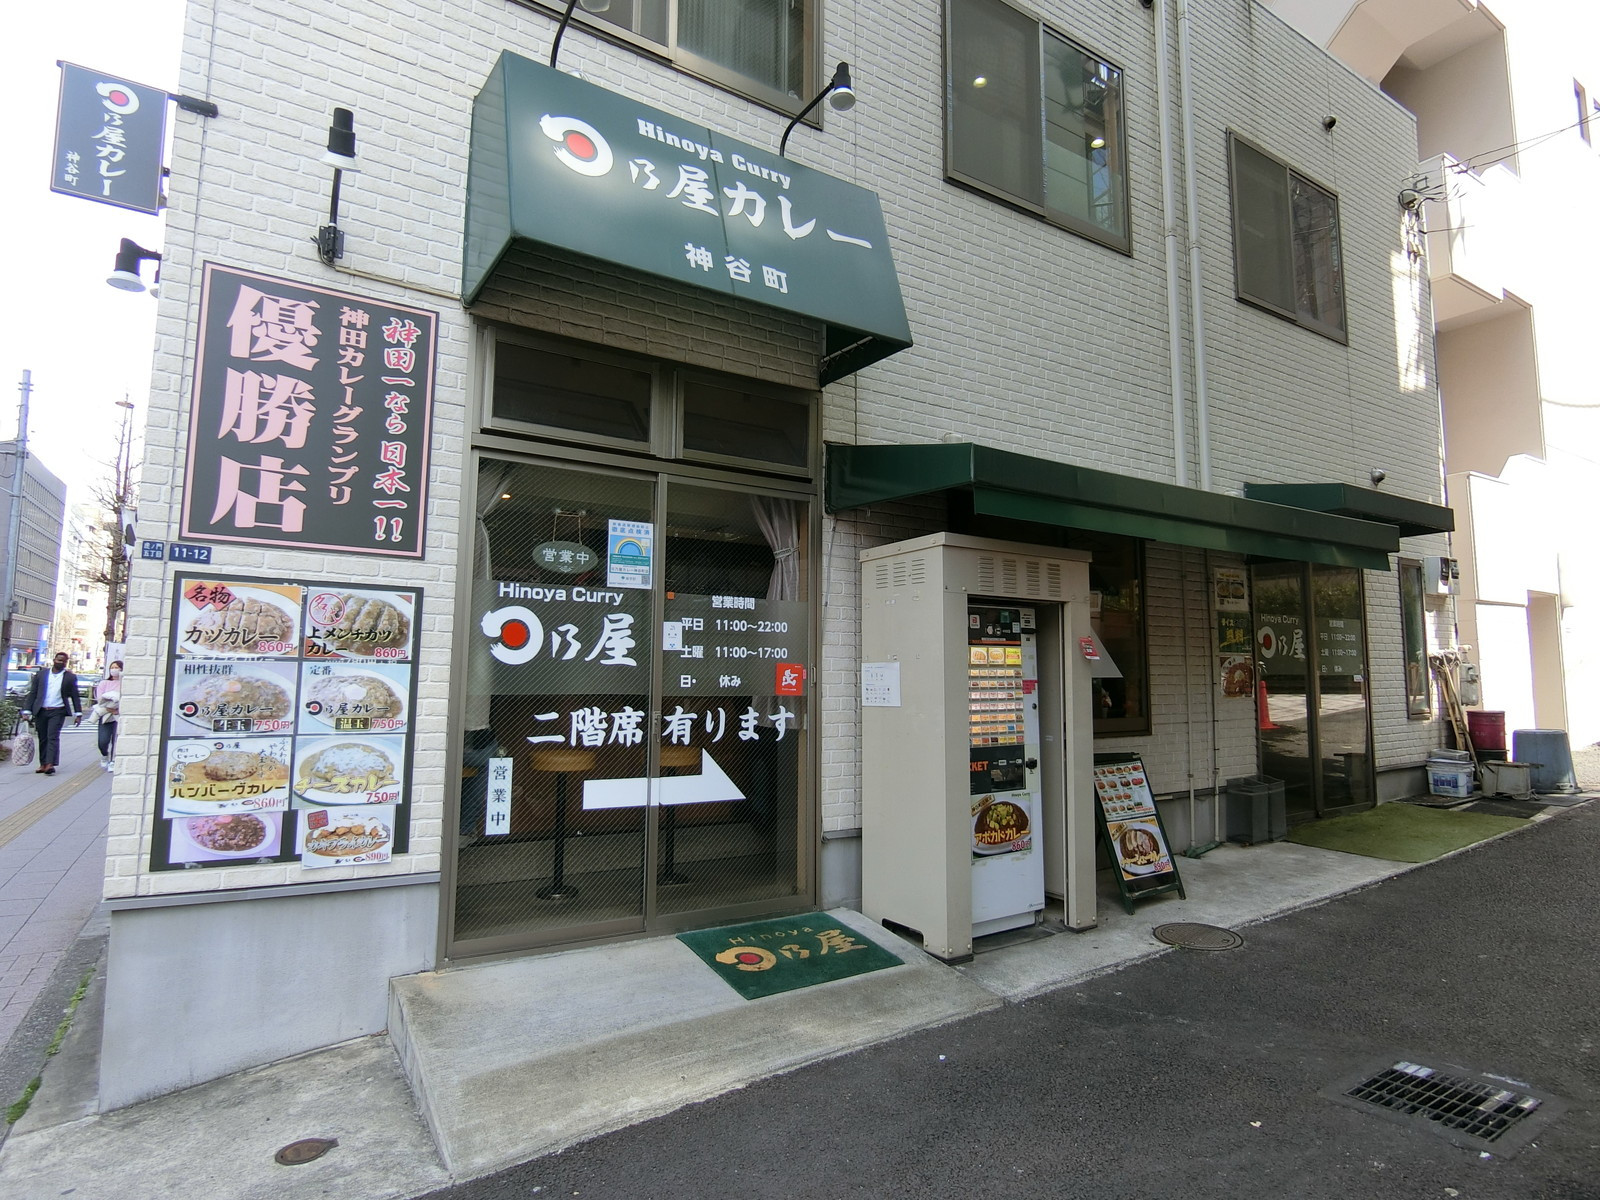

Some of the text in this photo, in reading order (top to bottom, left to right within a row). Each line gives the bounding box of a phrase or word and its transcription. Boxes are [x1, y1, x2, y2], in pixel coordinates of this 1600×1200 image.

[637, 118, 792, 190] Hinoya Curry
[684, 242, 789, 295] 神谷町
[209, 283, 323, 533] 優勝店
[328, 305, 371, 505] 神田カレーグランプリ
[173, 547, 208, 560] 11-12
[542, 547, 590, 565] 営業中
[189, 584, 232, 604] 名物
[499, 582, 624, 606] Hinoya Curry
[711, 595, 756, 610] 営業時間
[681, 617, 704, 631] 平日
[1260, 613, 1300, 626] Hinoya Curry
[184, 626, 279, 646] カツカレー
[307, 626, 393, 641] 上メンチカツ
[258, 641, 294, 652] 860円
[307, 642, 348, 656] カレー
[374, 647, 407, 658] 860円
[680, 644, 704, 659] 土曜
[719, 674, 742, 688] 休み
[218, 719, 291, 732] 生玉 750円
[340, 718, 404, 730] 温玉 750円
[526, 704, 796, 748] 二階席 有ります
[170, 782, 287, 799] ハンバーグカレー
[293, 773, 401, 796] チーズカレー
[253, 799, 286, 809] 860円
[366, 791, 398, 803] 750円
[490, 765, 509, 827] 営業中
[974, 827, 1031, 847] アボカドカレー
[728, 926, 815, 946] Hinoya
